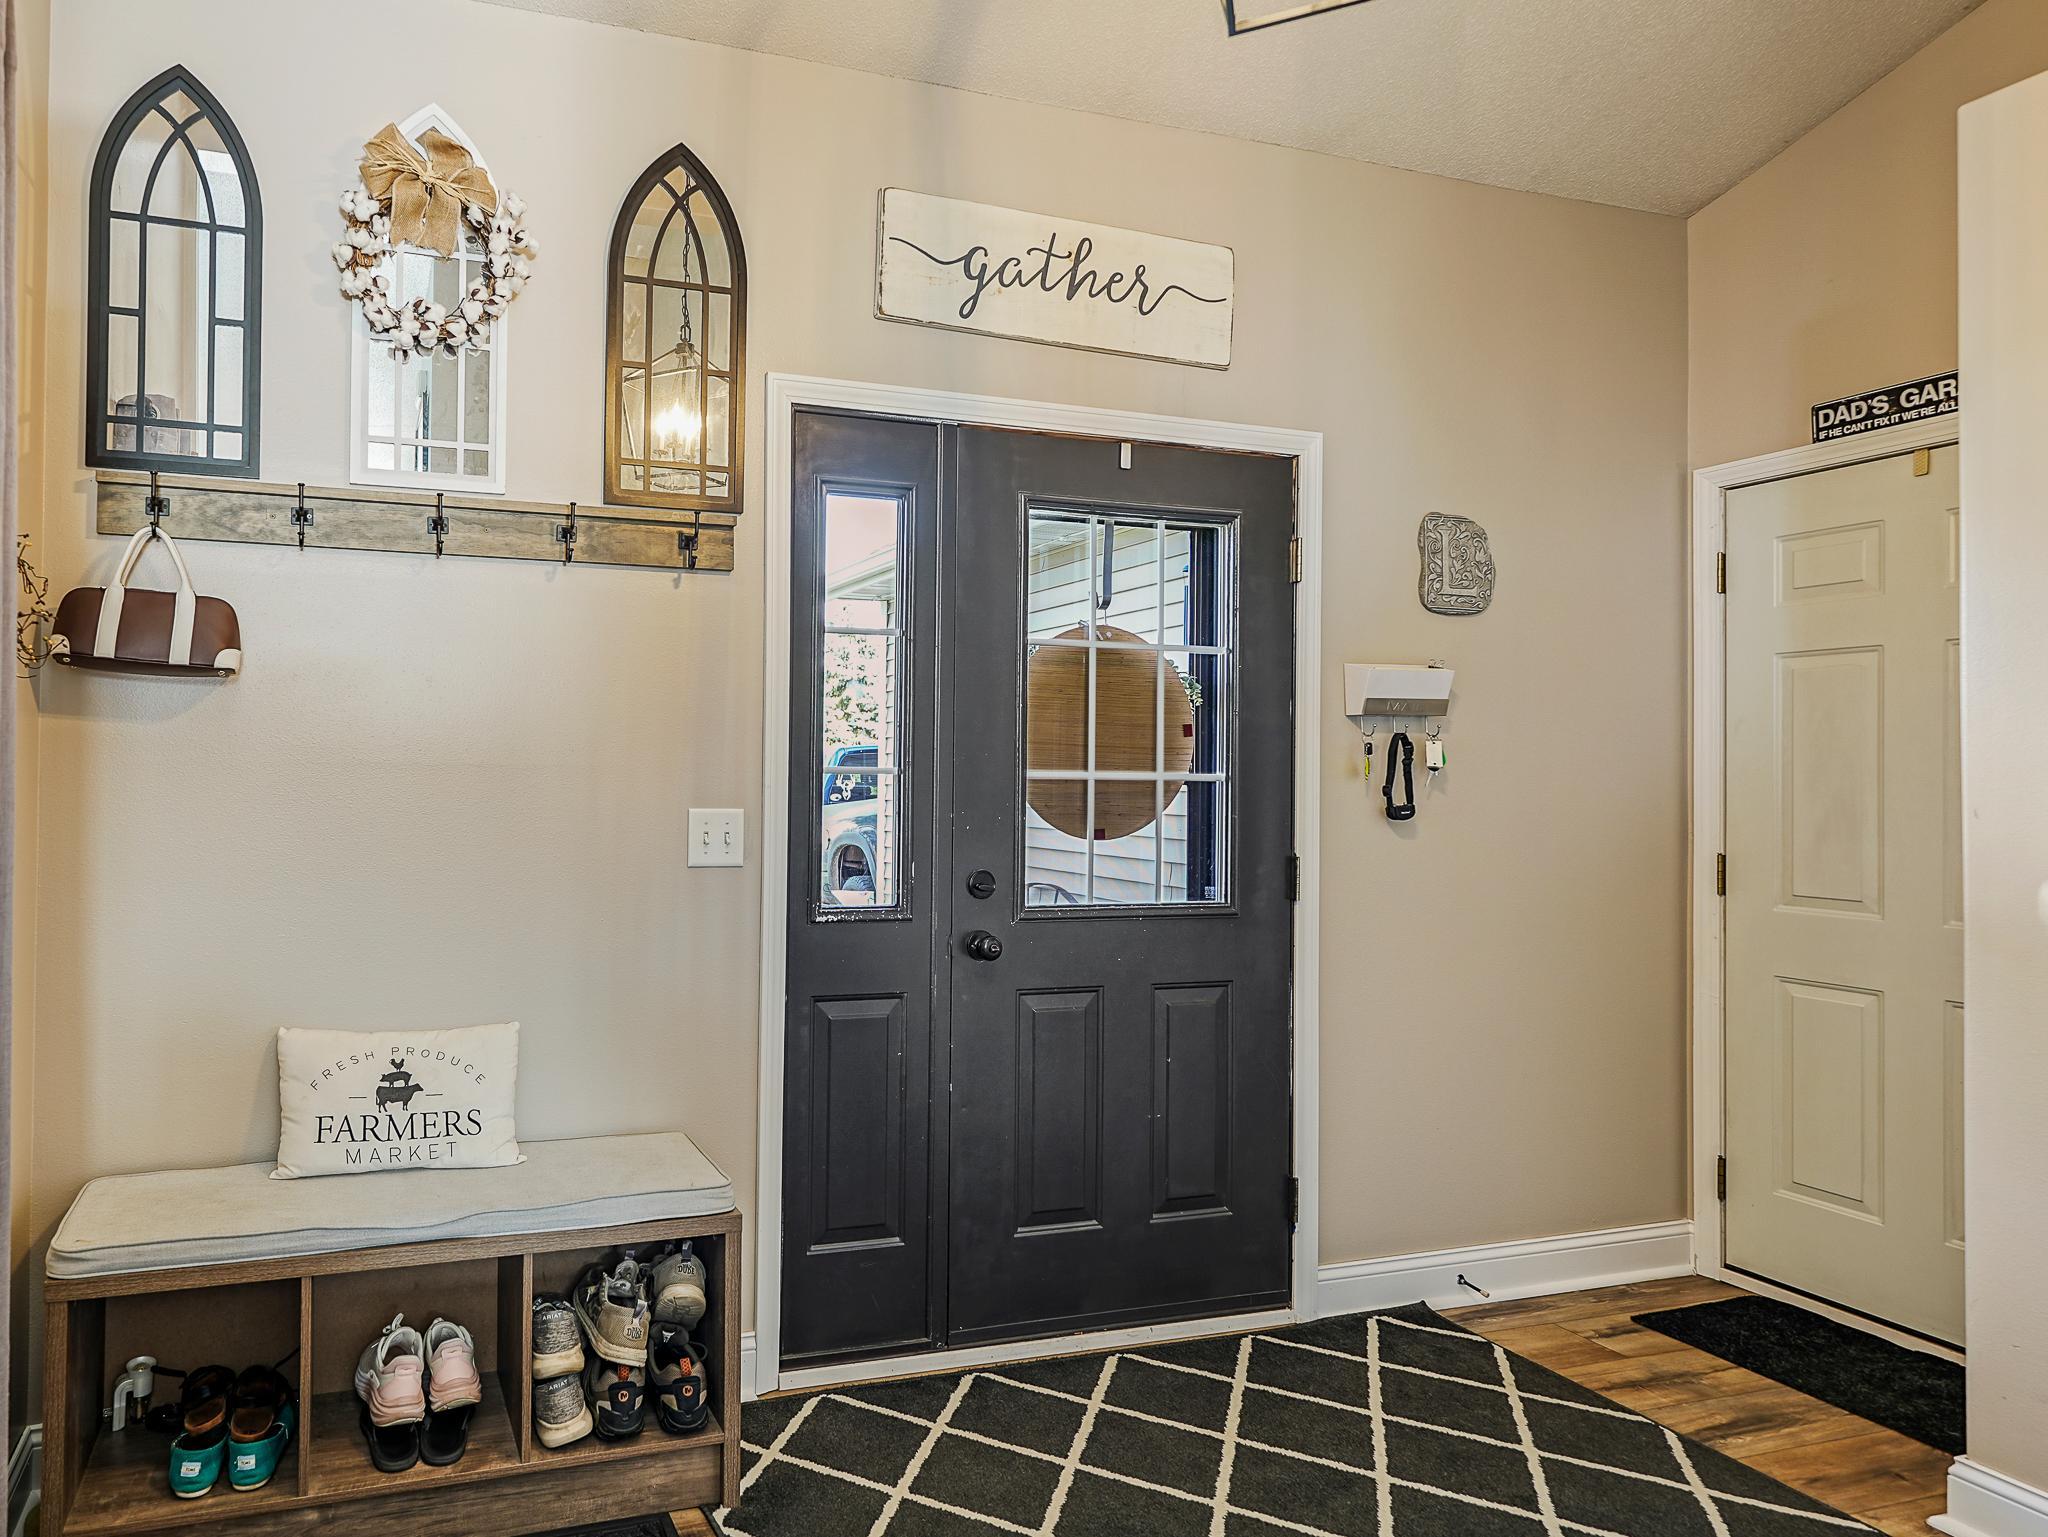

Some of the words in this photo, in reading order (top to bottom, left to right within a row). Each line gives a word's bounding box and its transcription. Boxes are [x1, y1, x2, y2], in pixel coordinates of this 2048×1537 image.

[889, 232, 1226, 319] gather
[1818, 395, 1889, 428] DAD'S
[1900, 379, 1958, 408] GAR
[1819, 430, 1828, 440] IF
[1829, 426, 1842, 438] HE
[1874, 417, 1889, 428] FIX
[1891, 414, 1901, 424] IT
[1438, 529, 1477, 598] L
[310, 1051, 375, 1091] FRESH
[391, 1046, 486, 1085] PRODUCE
[313, 1109, 482, 1144] FARMERS
[345, 1142, 457, 1165] MARKET
[542, 1312, 562, 1321] ARIAT
[548, 1379, 568, 1391] ARIAT
